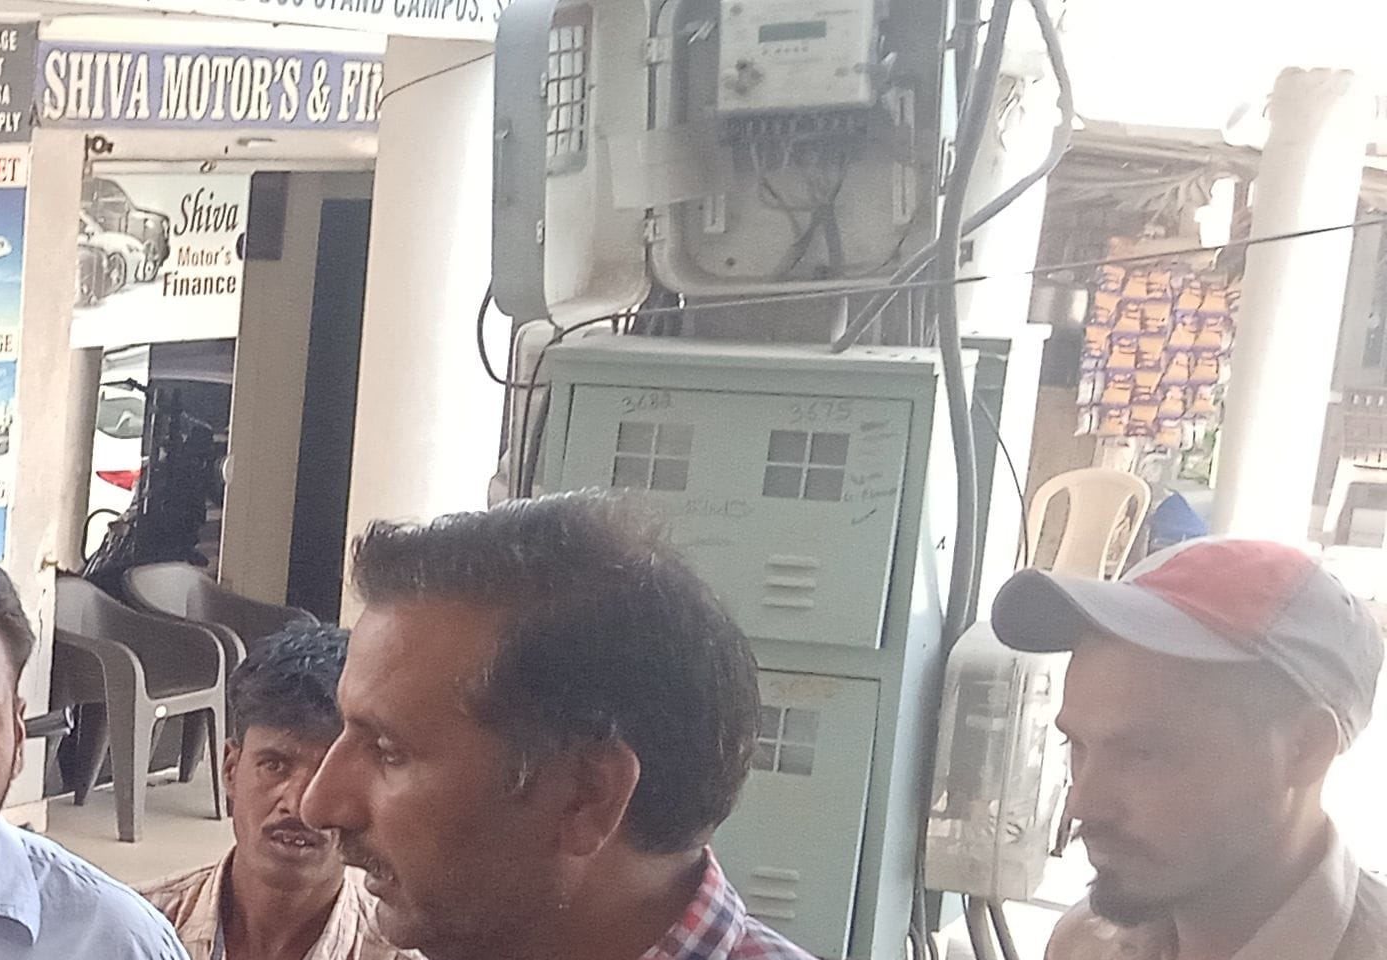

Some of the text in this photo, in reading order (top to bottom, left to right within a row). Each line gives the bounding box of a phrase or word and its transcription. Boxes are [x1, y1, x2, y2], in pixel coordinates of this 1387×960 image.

[41, 49, 151, 121] SHIVA
[158, 54, 303, 122] MOTOR'S
[306, 59, 332, 123] &
[173, 187, 239, 237] Shiva
[177, 245, 232, 267] Motor's
[162, 270, 237, 297] Finance
